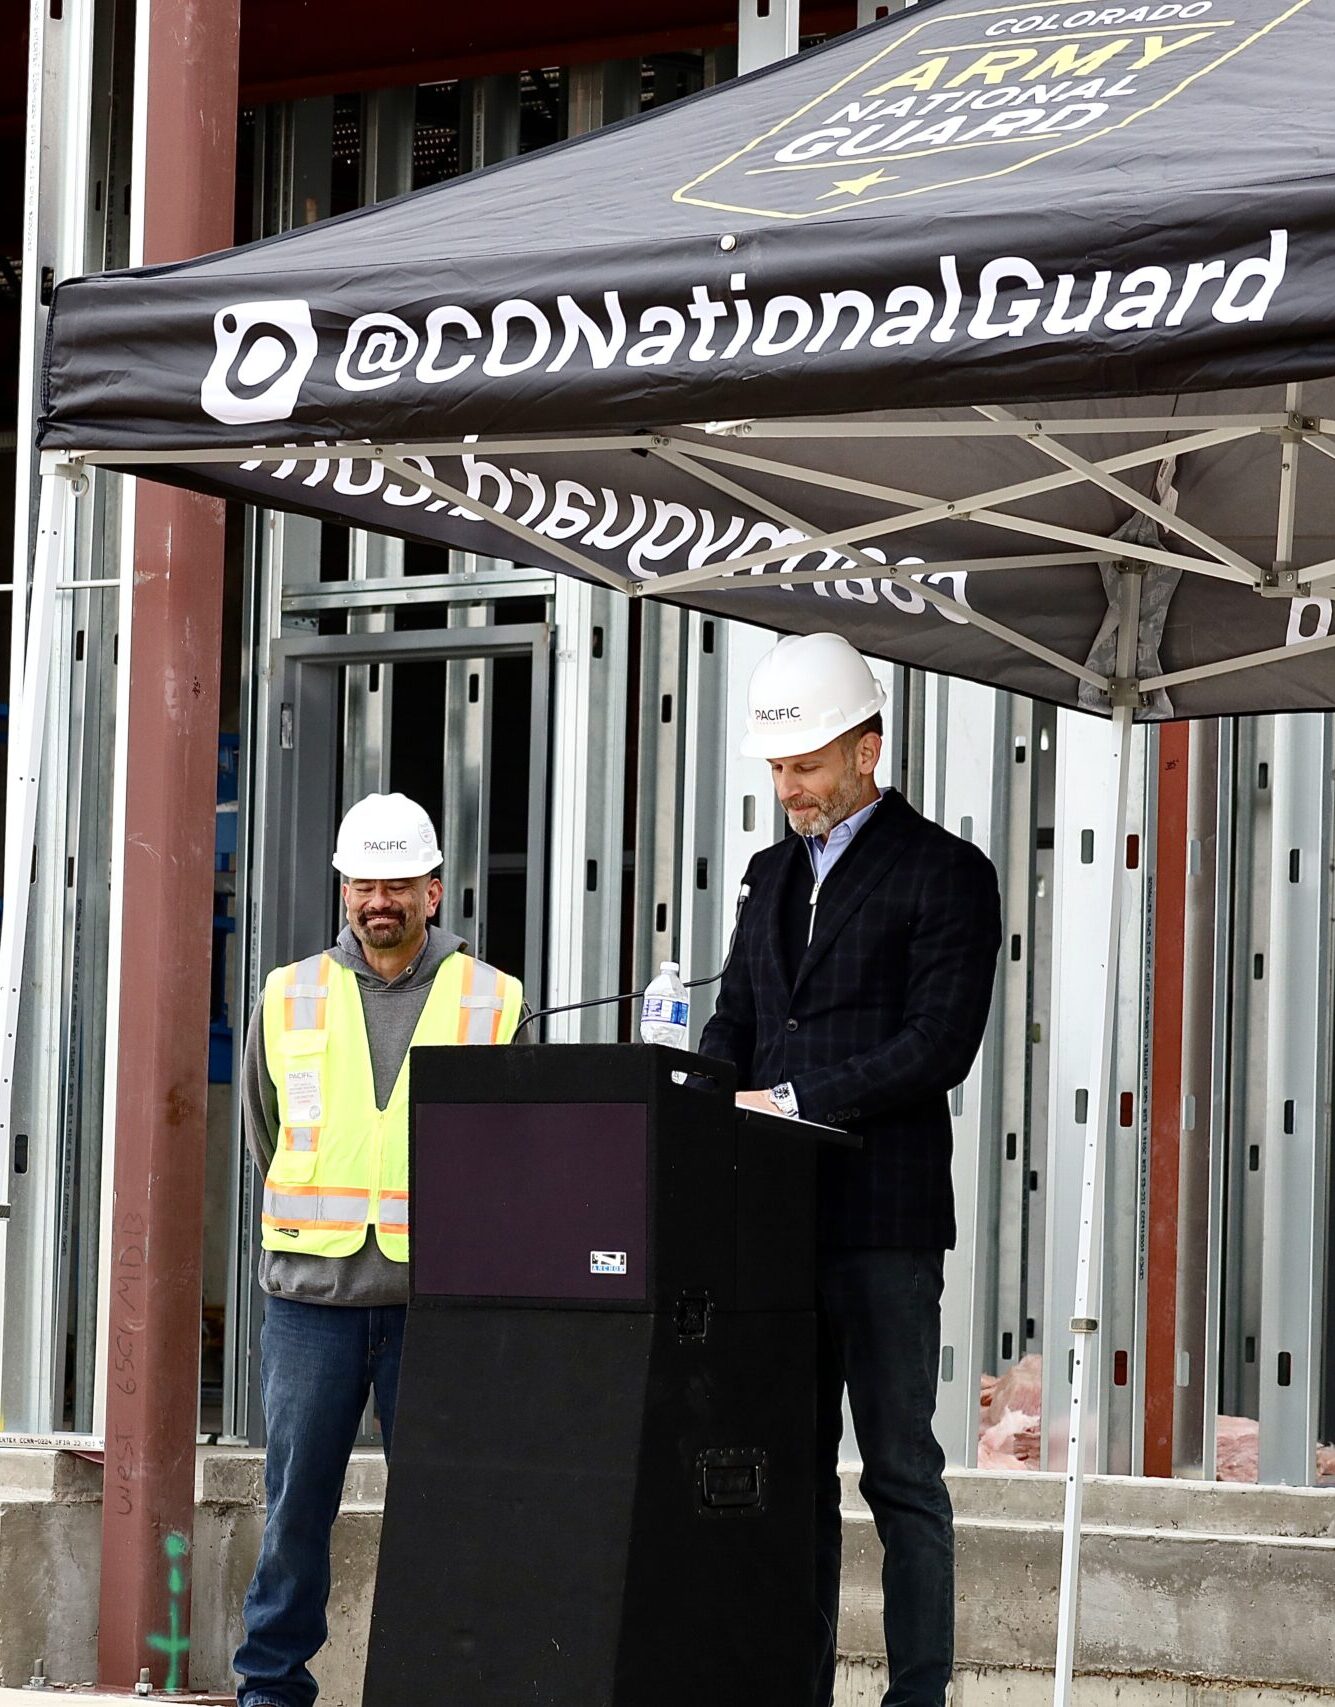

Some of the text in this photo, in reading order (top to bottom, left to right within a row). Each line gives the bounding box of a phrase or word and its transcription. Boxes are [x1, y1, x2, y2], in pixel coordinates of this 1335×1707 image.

[984, 1, 1213, 36] COLORADO
[862, 31, 1216, 97] ARMY
[829, 74, 1139, 125] NATIONAL
[773, 102, 1110, 164] GUARD
[334, 229, 1290, 391] @CONationalGuard
[755, 706, 801, 721] PACIFIC
[364, 840, 407, 851] PACIFIC
